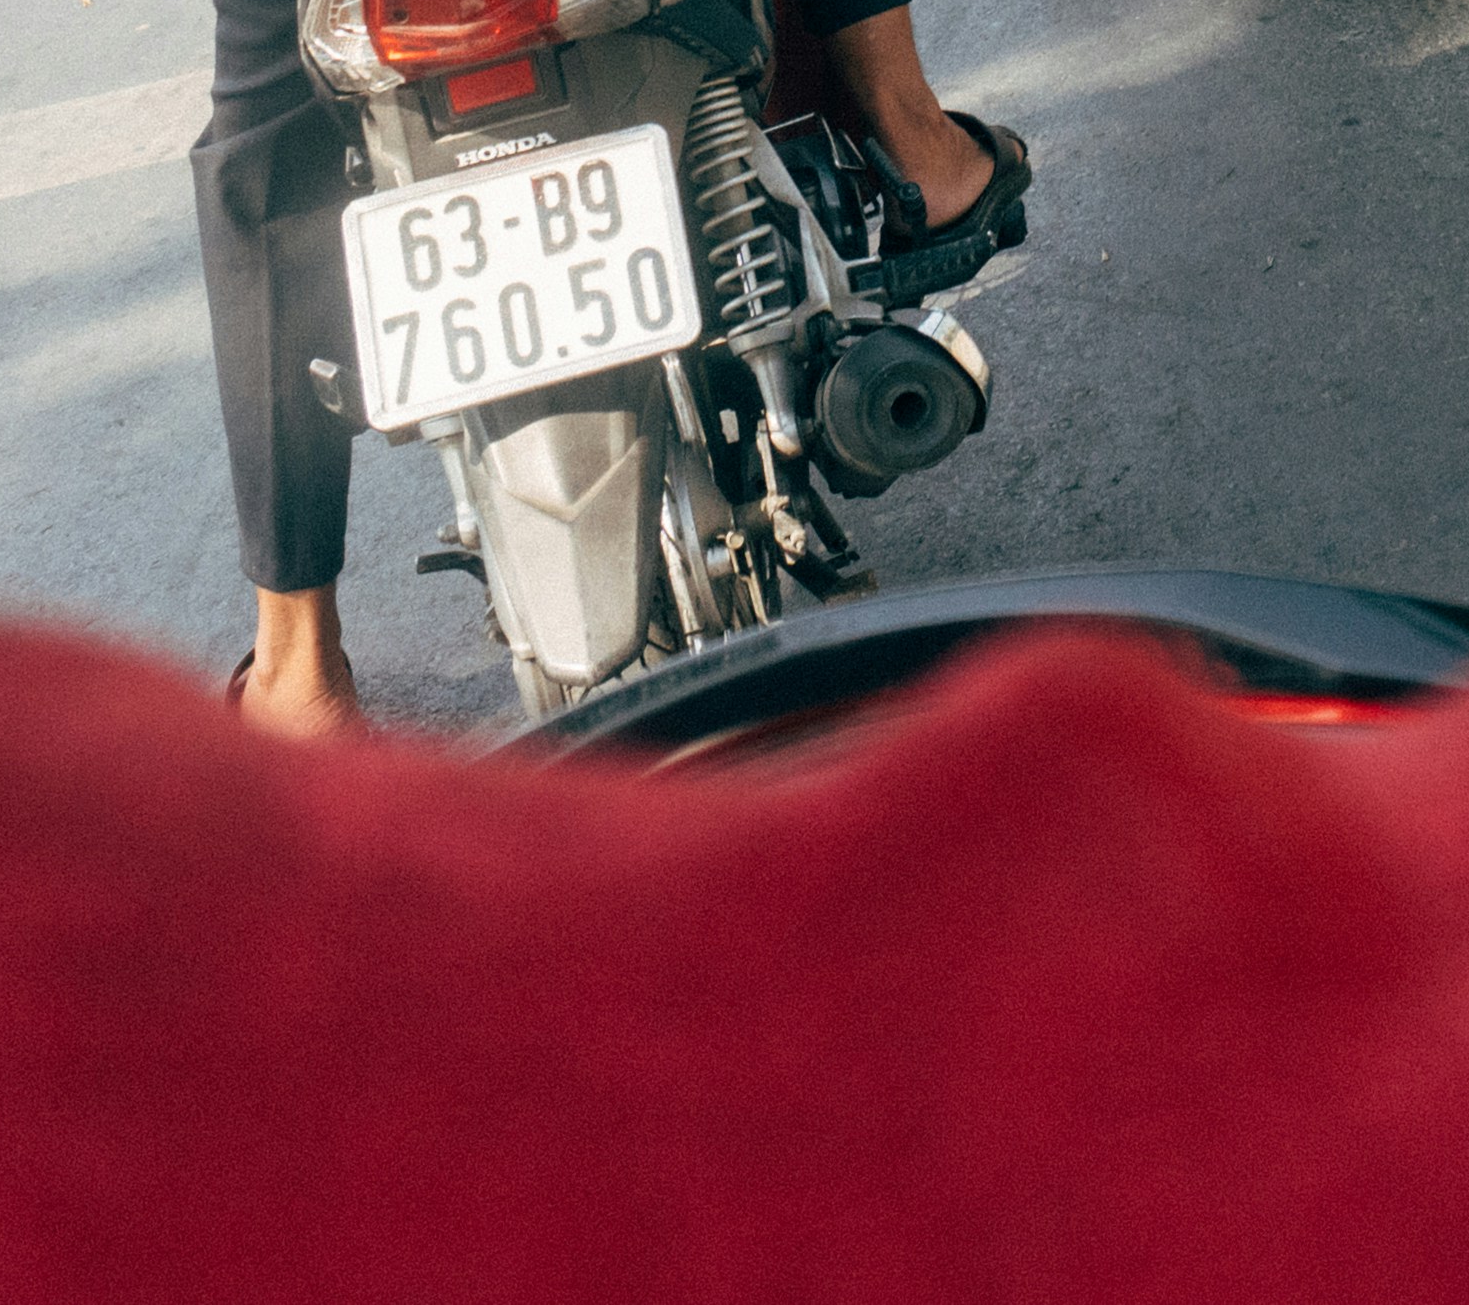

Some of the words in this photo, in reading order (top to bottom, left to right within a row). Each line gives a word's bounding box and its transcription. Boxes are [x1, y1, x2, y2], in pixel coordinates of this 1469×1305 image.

[455, 131, 558, 168] HONDA
[397, 158, 624, 292] 63-B9
[383, 246, 674, 406] 760.50
